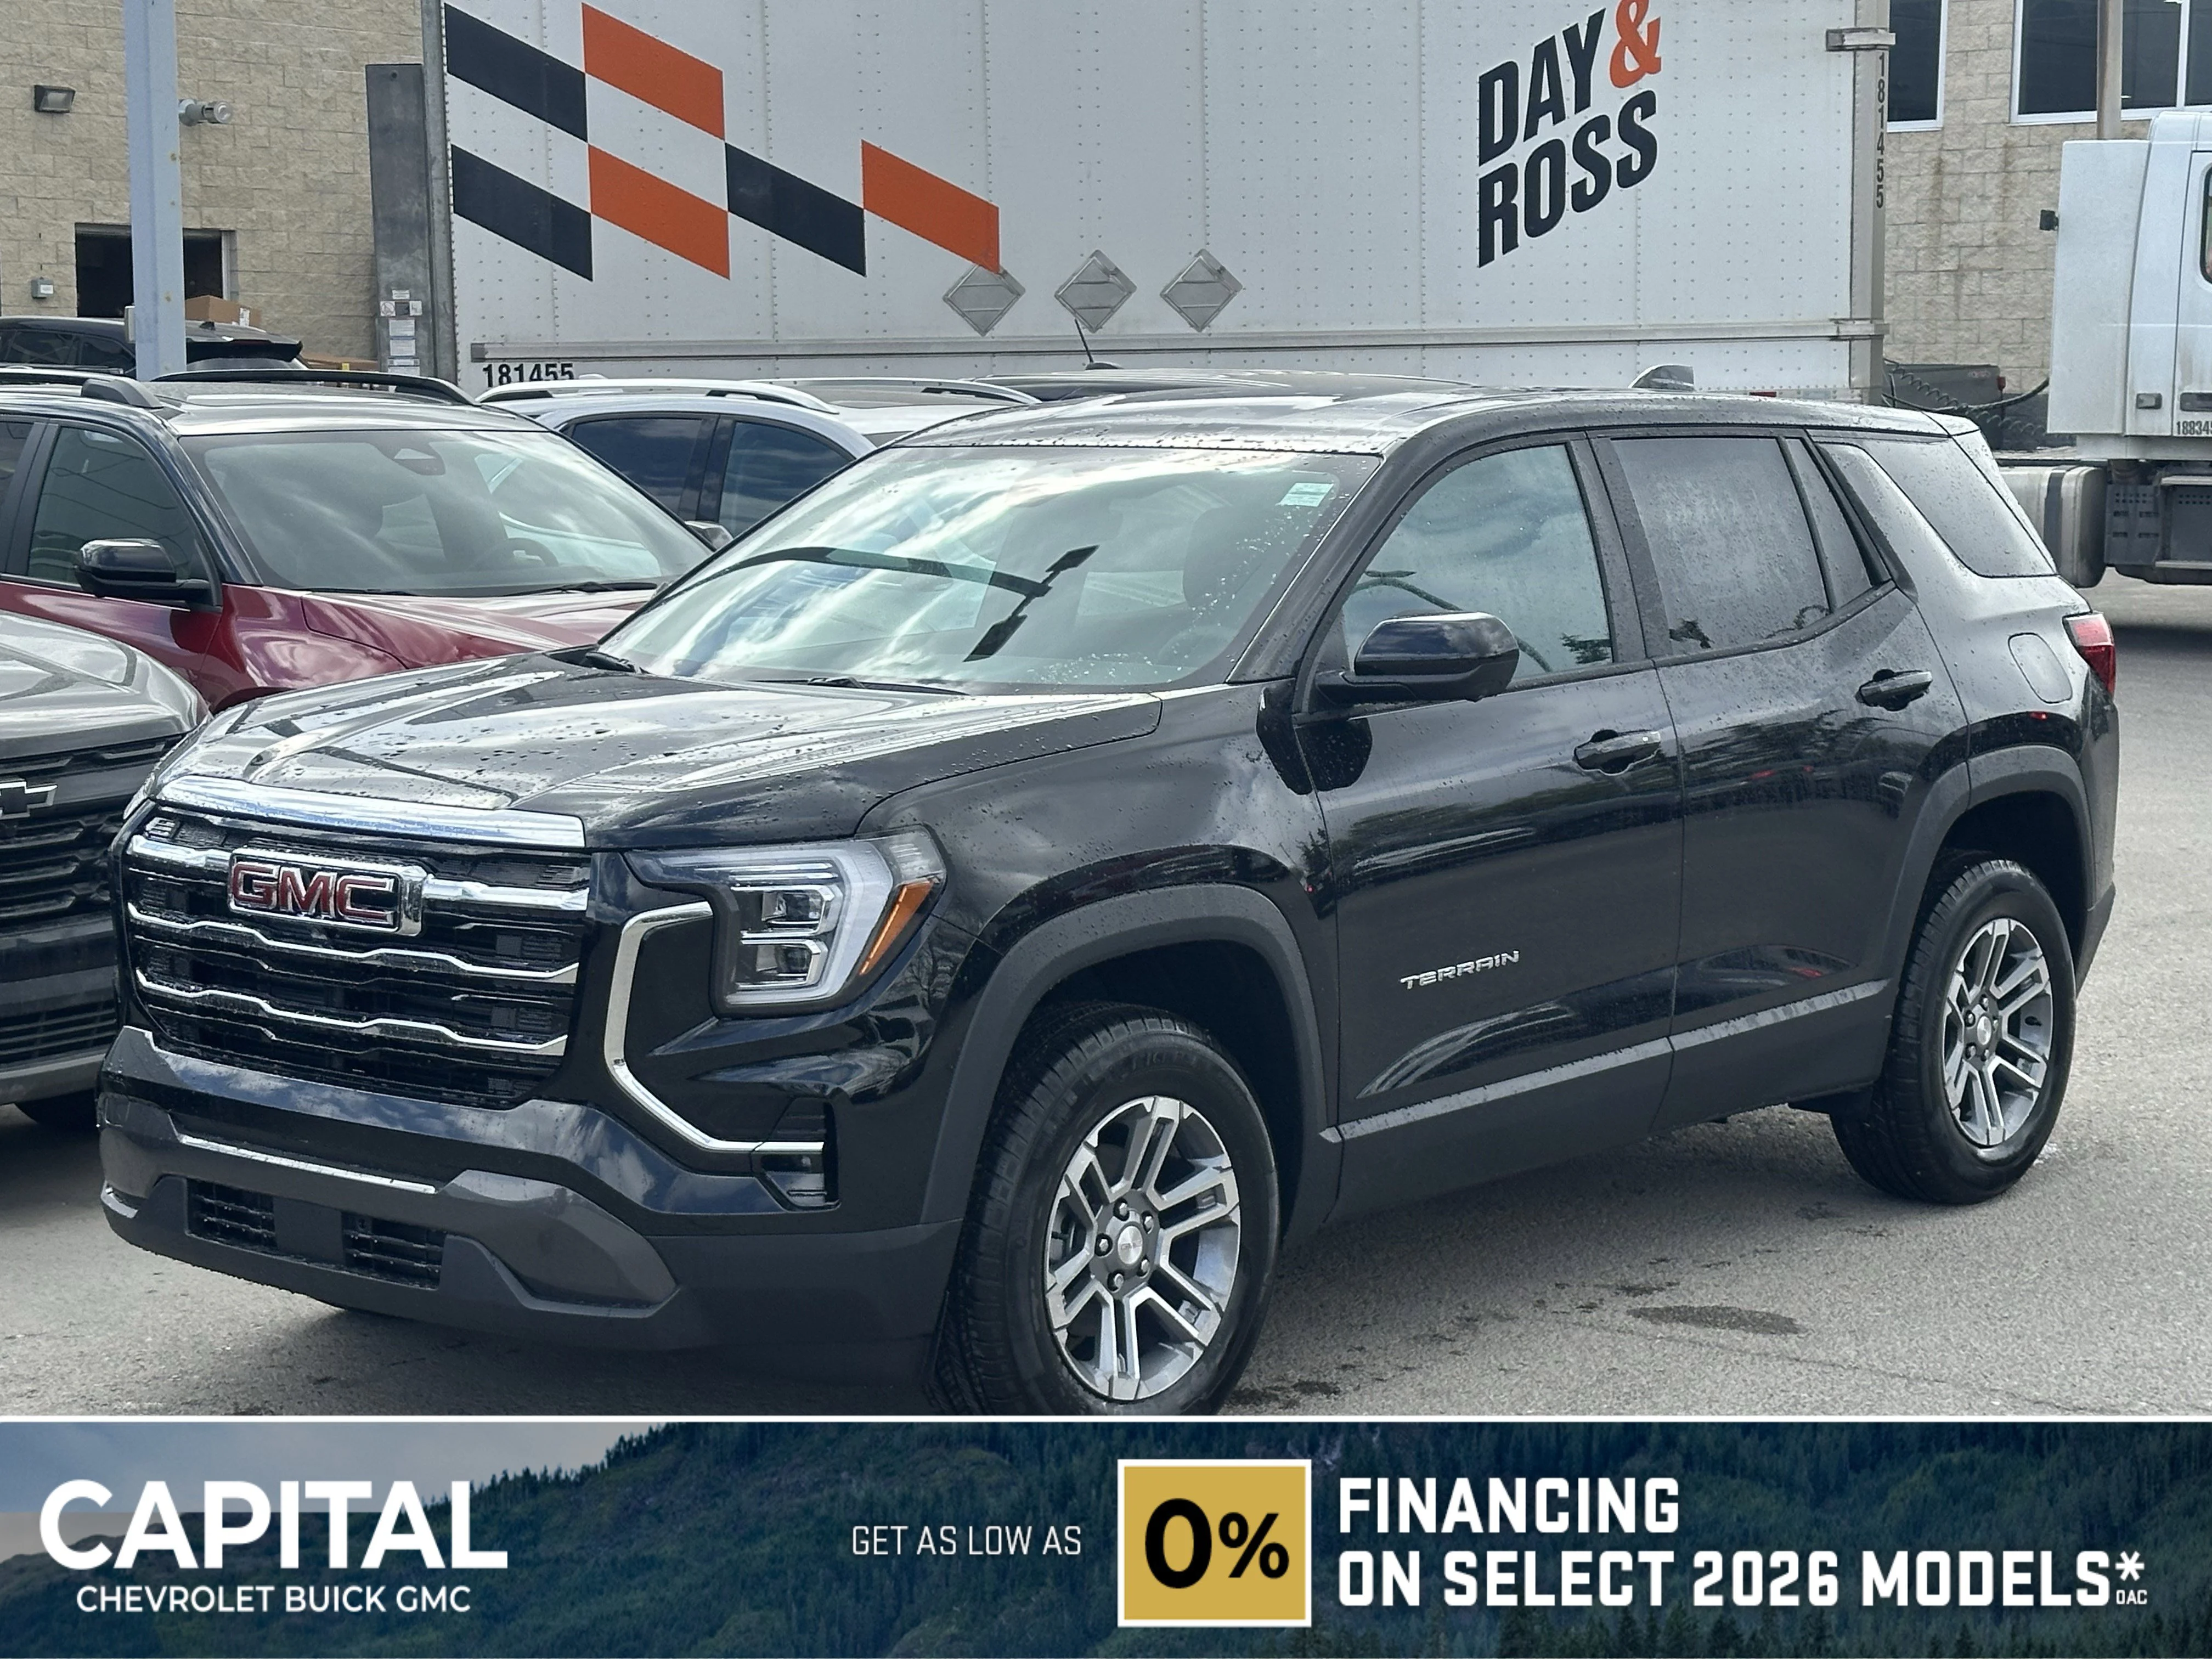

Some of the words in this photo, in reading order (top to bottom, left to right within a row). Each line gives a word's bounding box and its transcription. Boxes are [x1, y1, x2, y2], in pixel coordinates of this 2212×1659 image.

[1479, 7, 1606, 167] DAY
[1609, 0, 1662, 88] &
[1876, 52, 1885, 208] 181455
[1479, 90, 1657, 269] ROSS
[483, 363, 574, 387] 181455
[2176, 420, 2212, 435] 18834
[232, 861, 394, 926] GMC
[1400, 950, 1520, 990] TERRAIN
